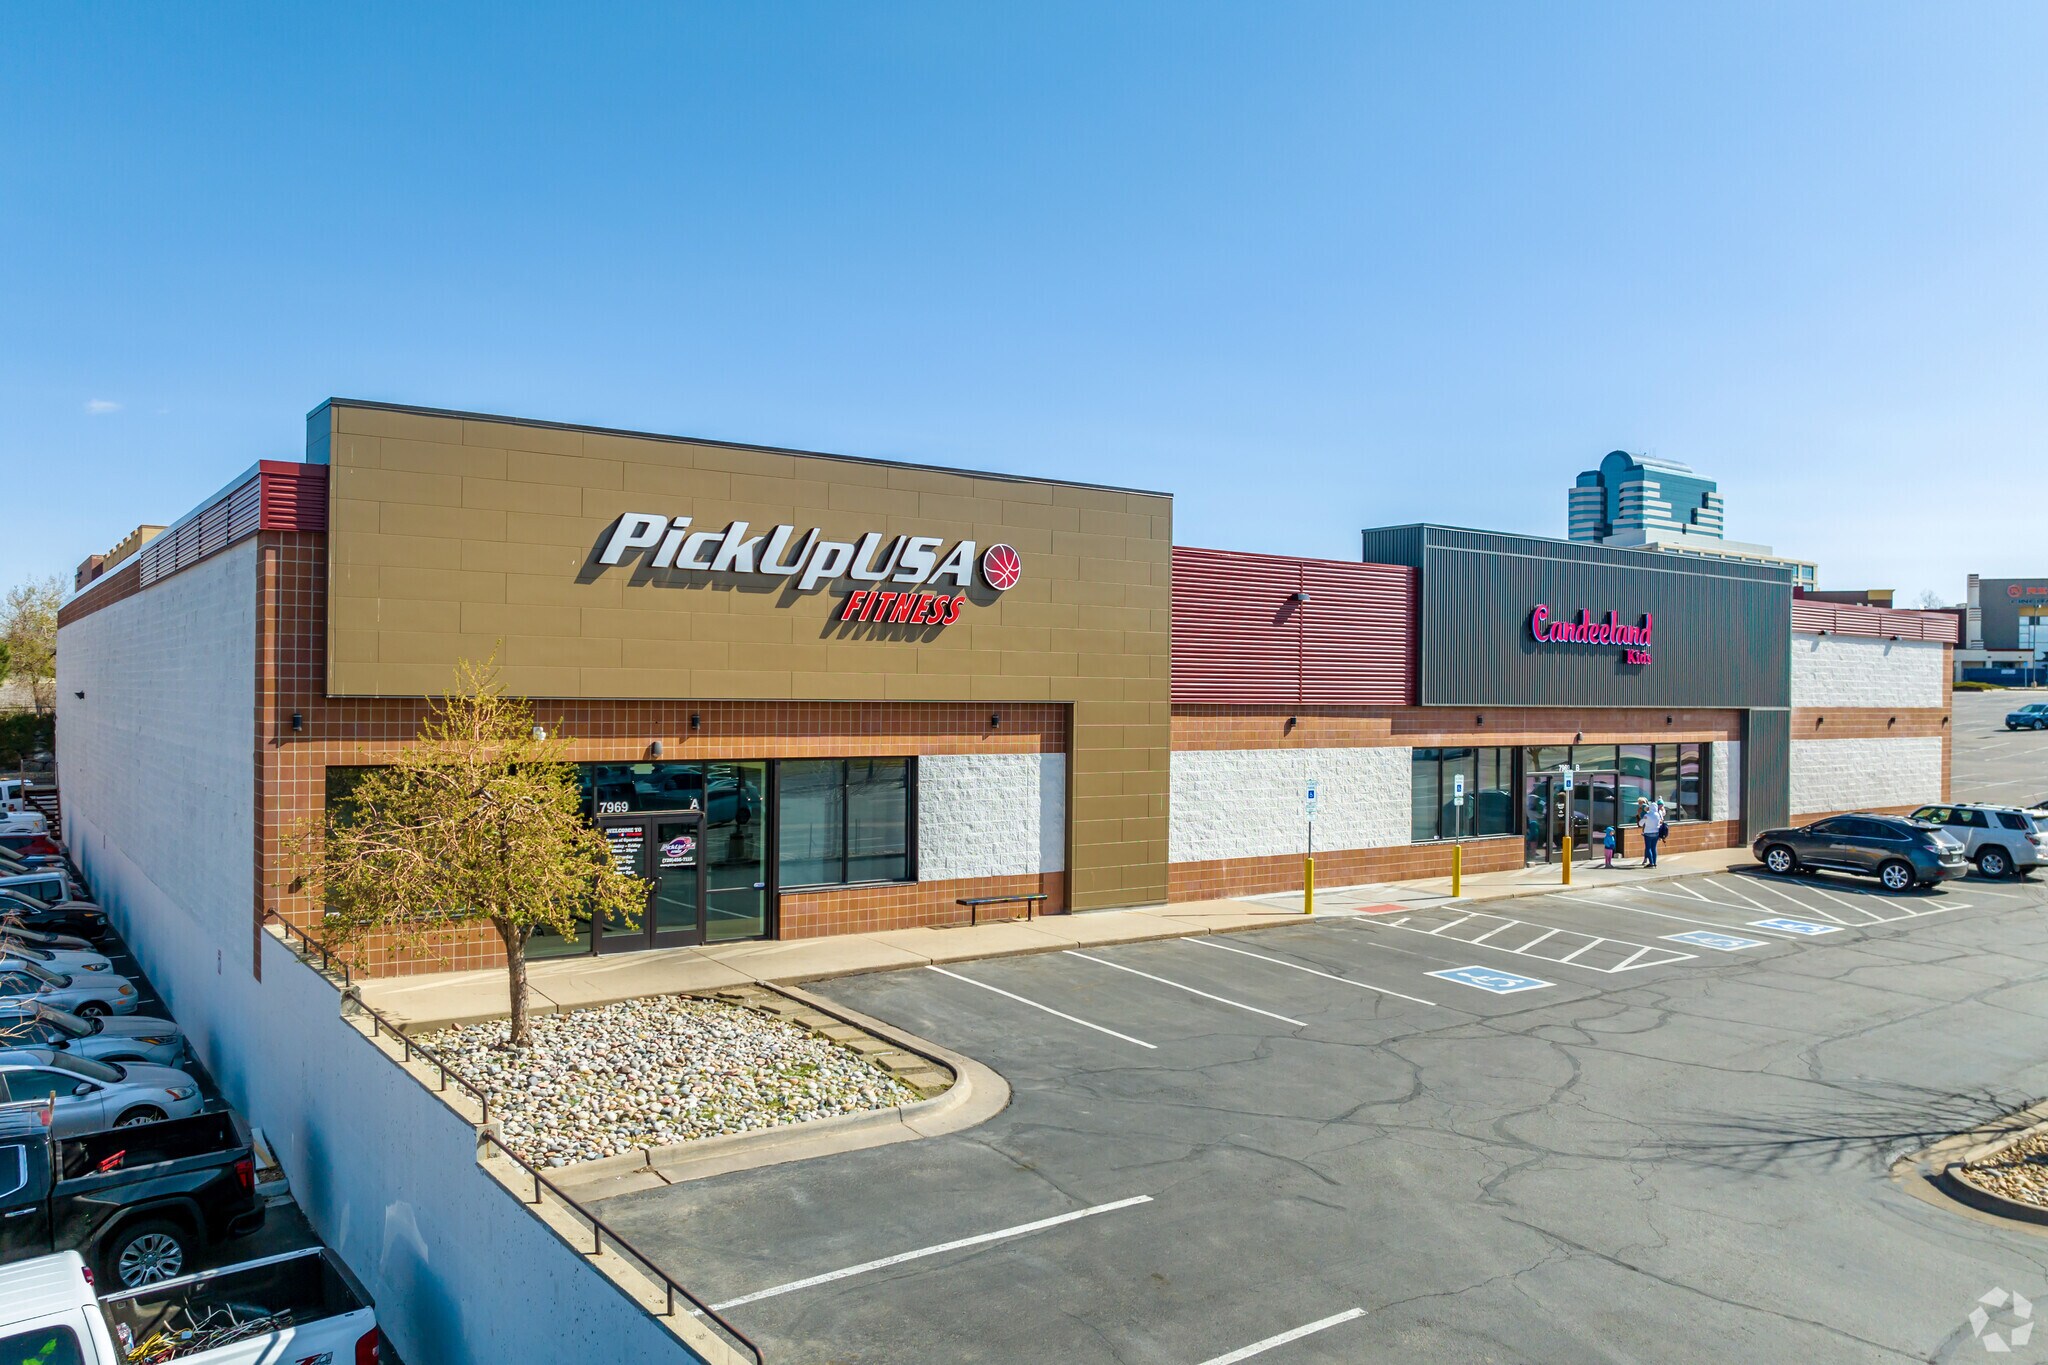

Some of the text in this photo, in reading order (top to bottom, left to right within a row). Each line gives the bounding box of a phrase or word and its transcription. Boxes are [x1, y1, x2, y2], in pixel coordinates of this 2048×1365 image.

[599, 512, 977, 590] PickUpUSA
[840, 590, 967, 626] FITNESS
[1531, 603, 1652, 646] Candeeland
[1625, 649, 1652, 665] Kids
[600, 798, 699, 813] 7969 A
